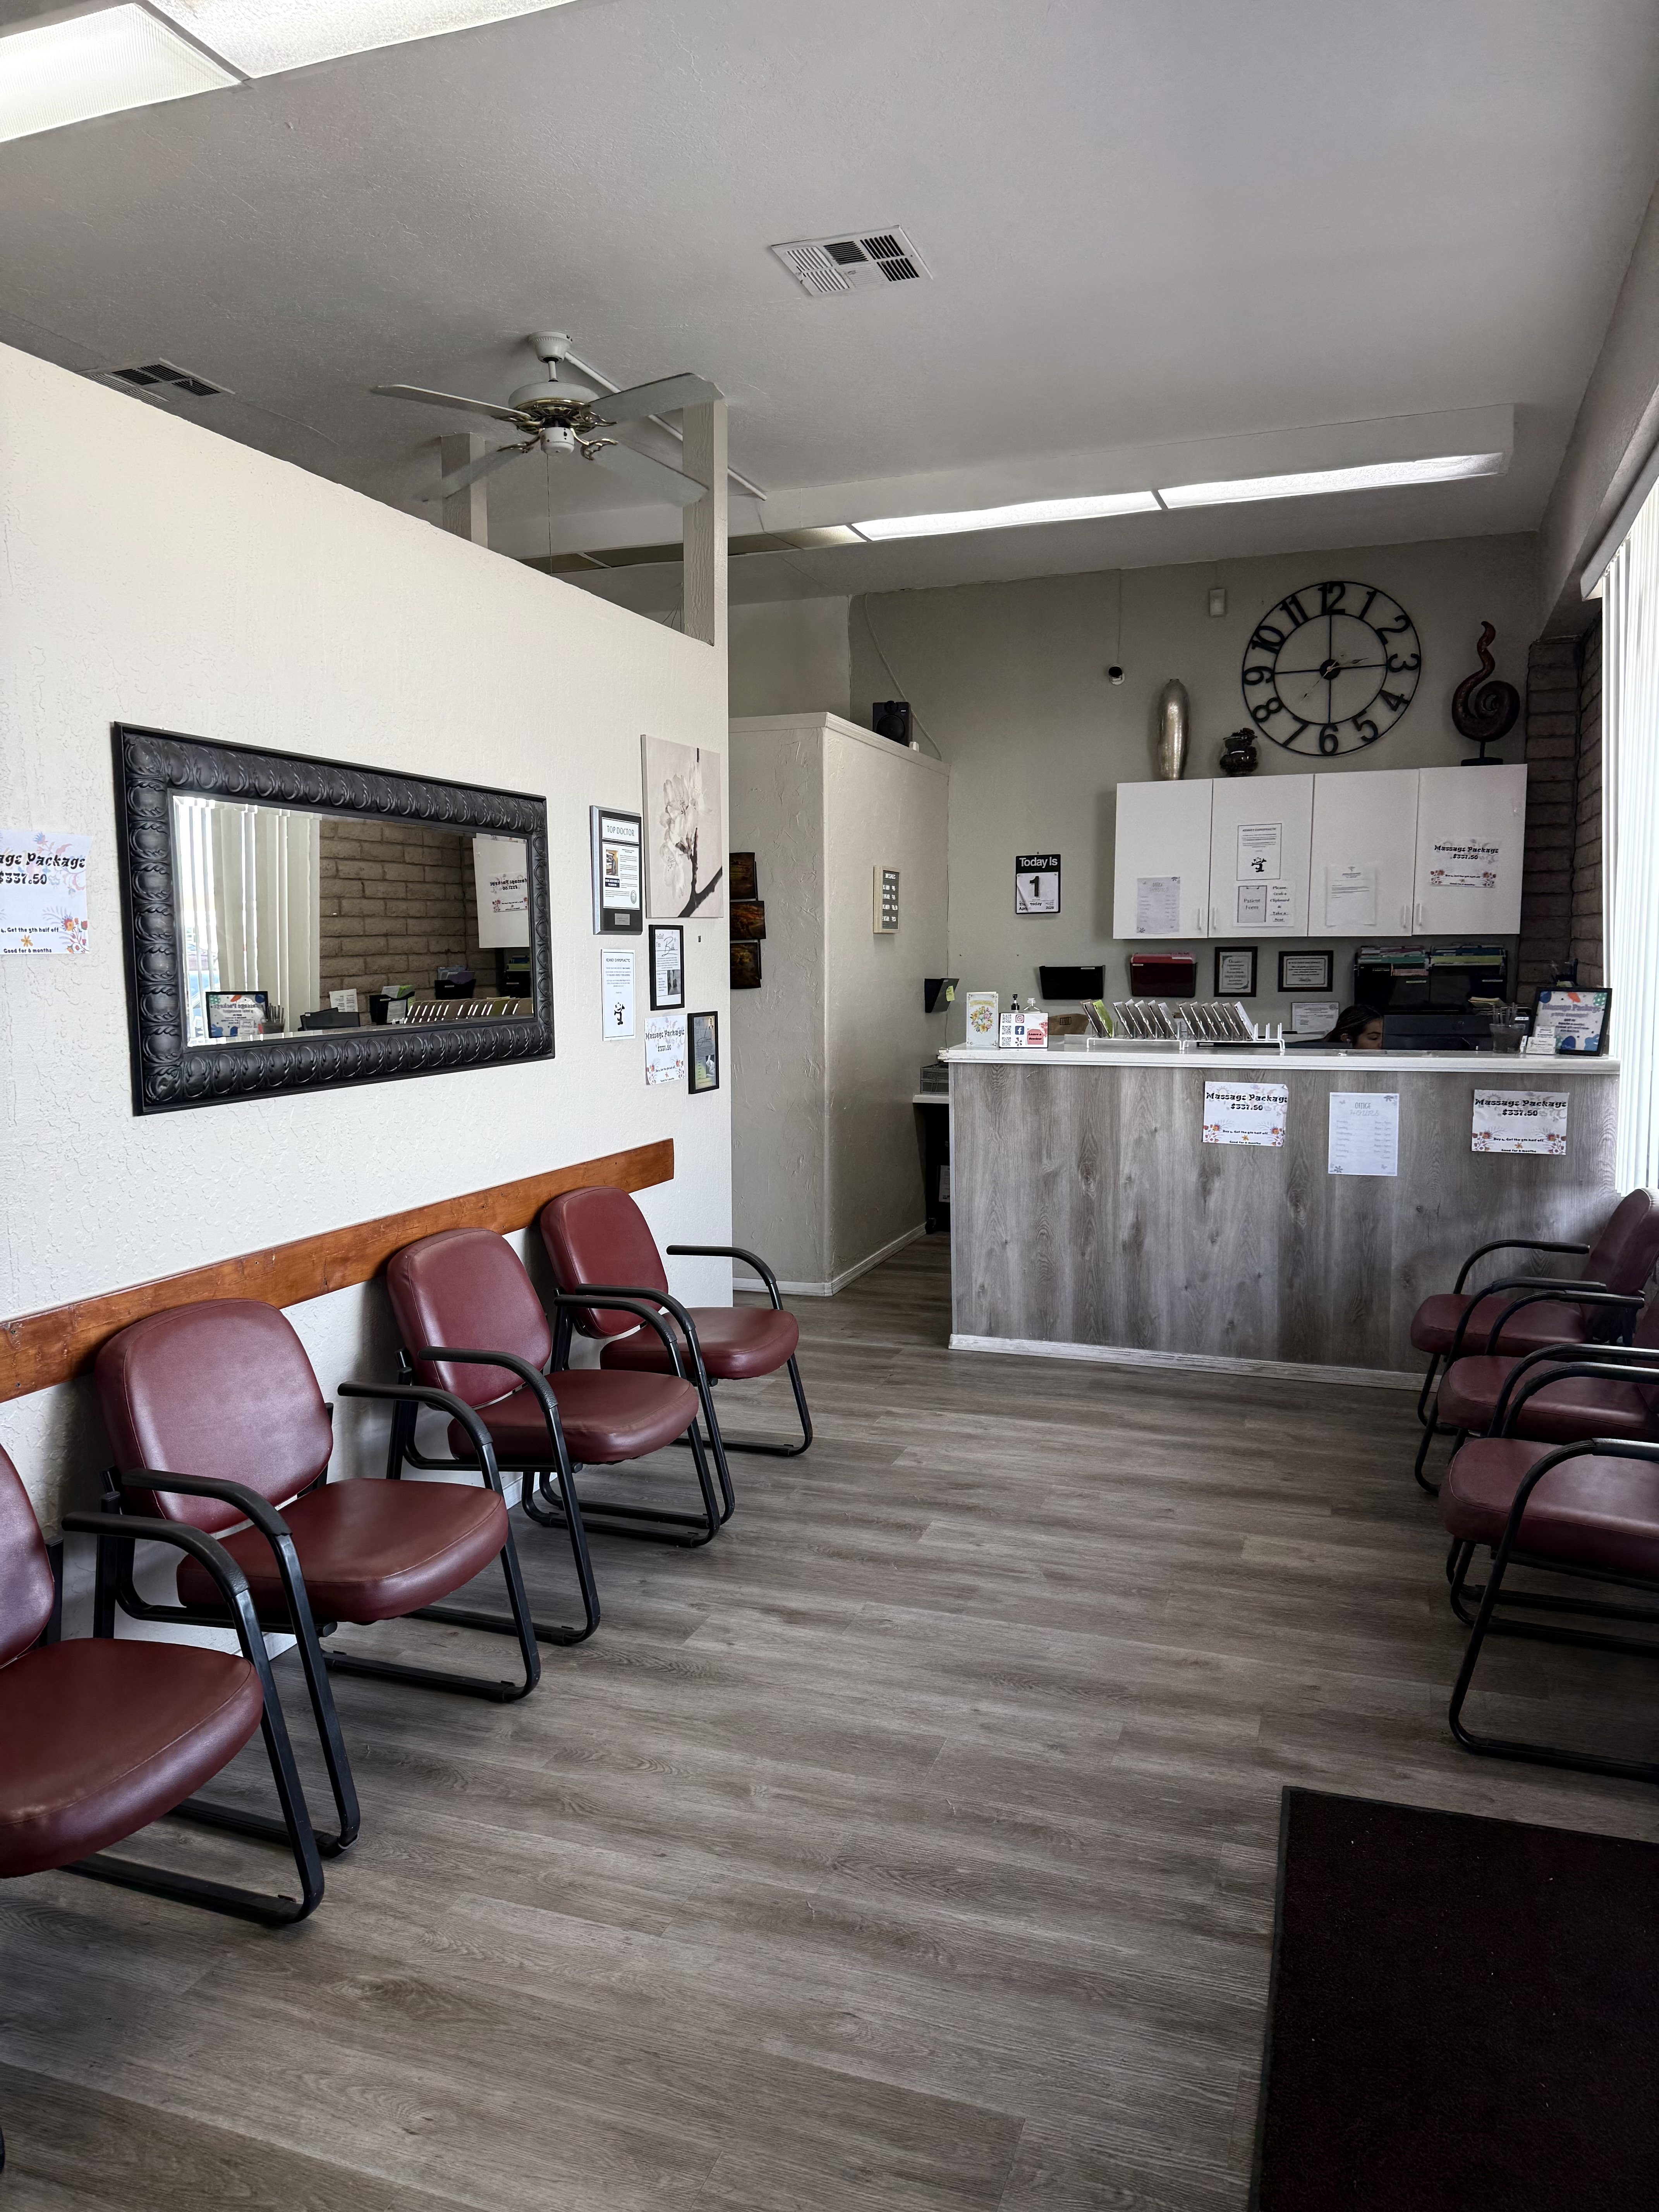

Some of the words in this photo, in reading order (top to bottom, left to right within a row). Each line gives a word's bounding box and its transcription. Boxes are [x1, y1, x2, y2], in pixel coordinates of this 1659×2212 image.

[1318, 582, 1346, 615] 12
[1358, 589, 1377, 620] 1
[1279, 594, 1309, 627] 11
[1252, 625, 1285, 654] 10
[1376, 615, 1410, 645] 2
[1386, 653, 1421, 673] 3
[1243, 666, 1274, 685] 9
[1251, 697, 1283, 723] 8
[1379, 689, 1410, 712] 4
[1281, 715, 1310, 748] 7
[1352, 709, 1379, 742] 5
[1319, 723, 1338, 755] 6
[617, 827, 635, 836] DOCTOR
[26, 853, 85, 869] Package
[1019, 857, 1048, 868] Today
[1049, 857, 1058, 866] Is
[1029, 876, 1039, 897] 1
[664, 1029, 685, 1037] Package
[1206, 1092, 1247, 1101] Massage
[1249, 1094, 1288, 1103] Package
[1475, 1099, 1520, 1107] Massage
[1522, 1100, 1566, 1108] Package
